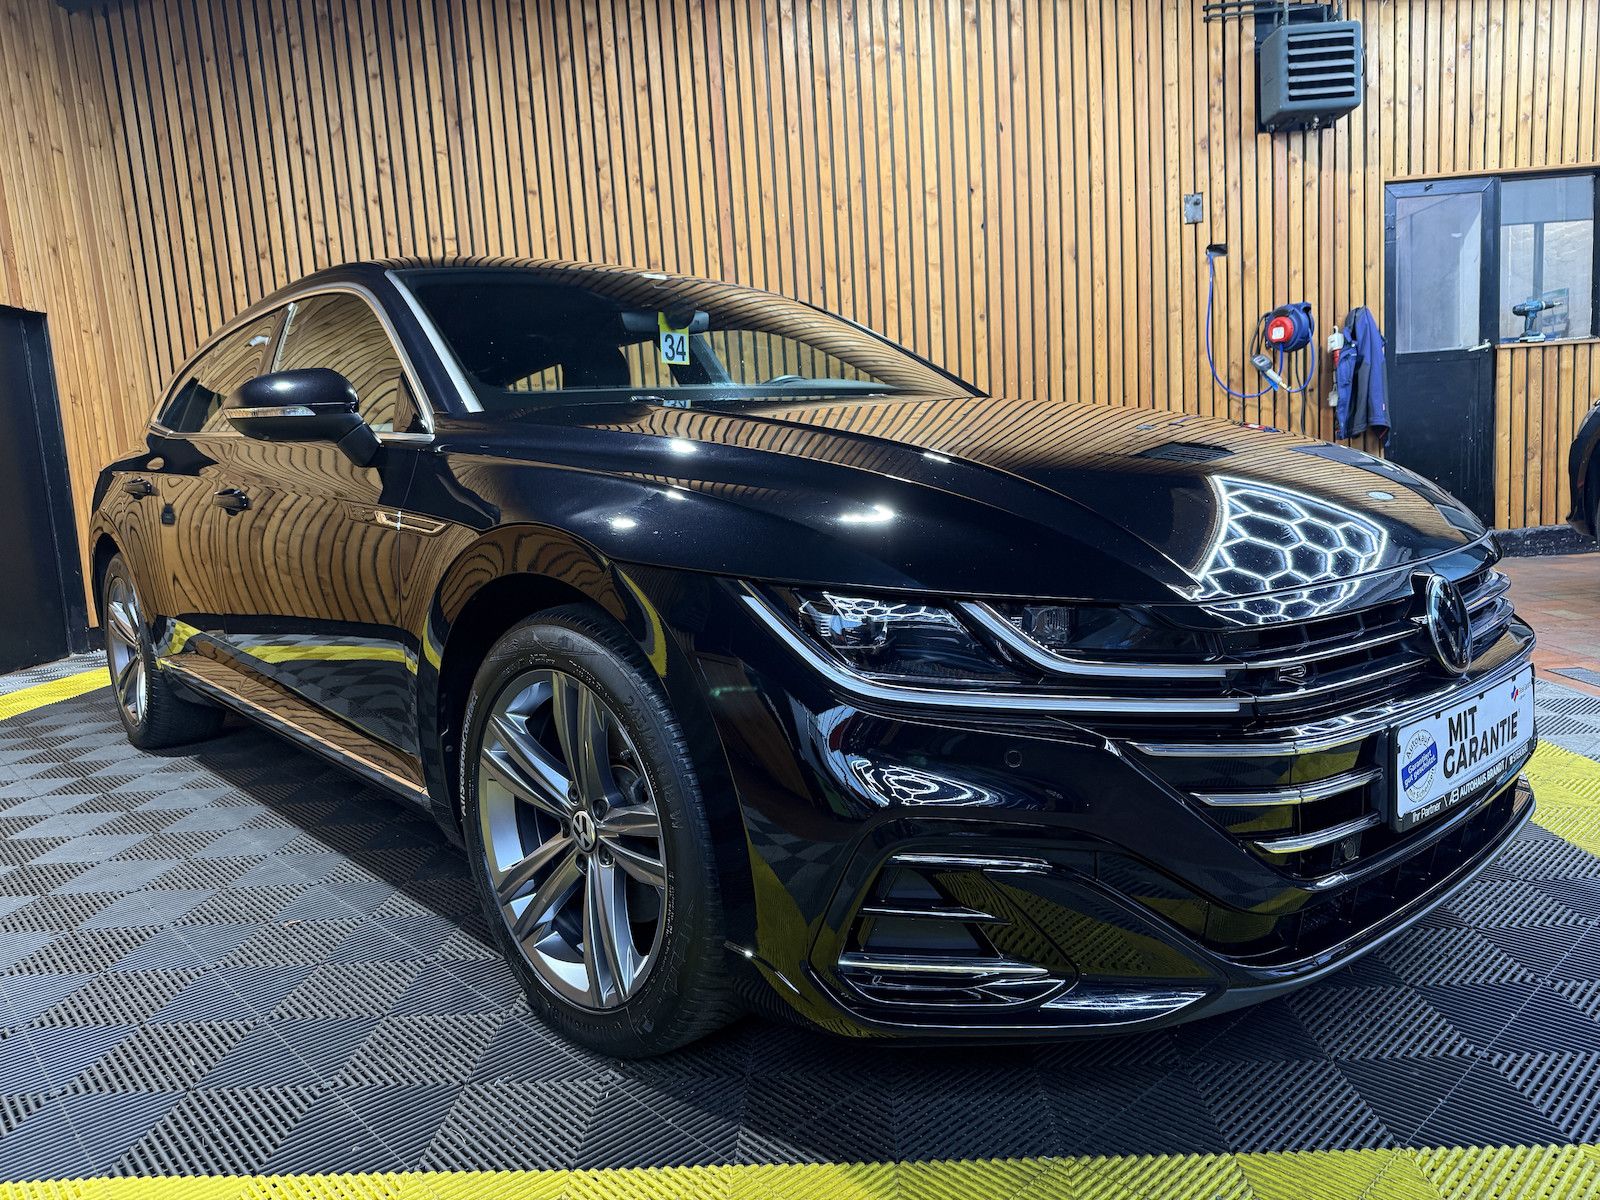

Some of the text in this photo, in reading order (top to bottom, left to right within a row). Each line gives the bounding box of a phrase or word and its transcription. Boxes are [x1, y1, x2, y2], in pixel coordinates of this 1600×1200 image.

[664, 333, 686, 362] 34
[1443, 711, 1518, 779] GARANTIE
[1448, 705, 1477, 747] MIT
[1412, 812, 1420, 823] Ihr
[1420, 801, 1442, 819] Partner
[1460, 774, 1487, 797] AUTOHAUS
